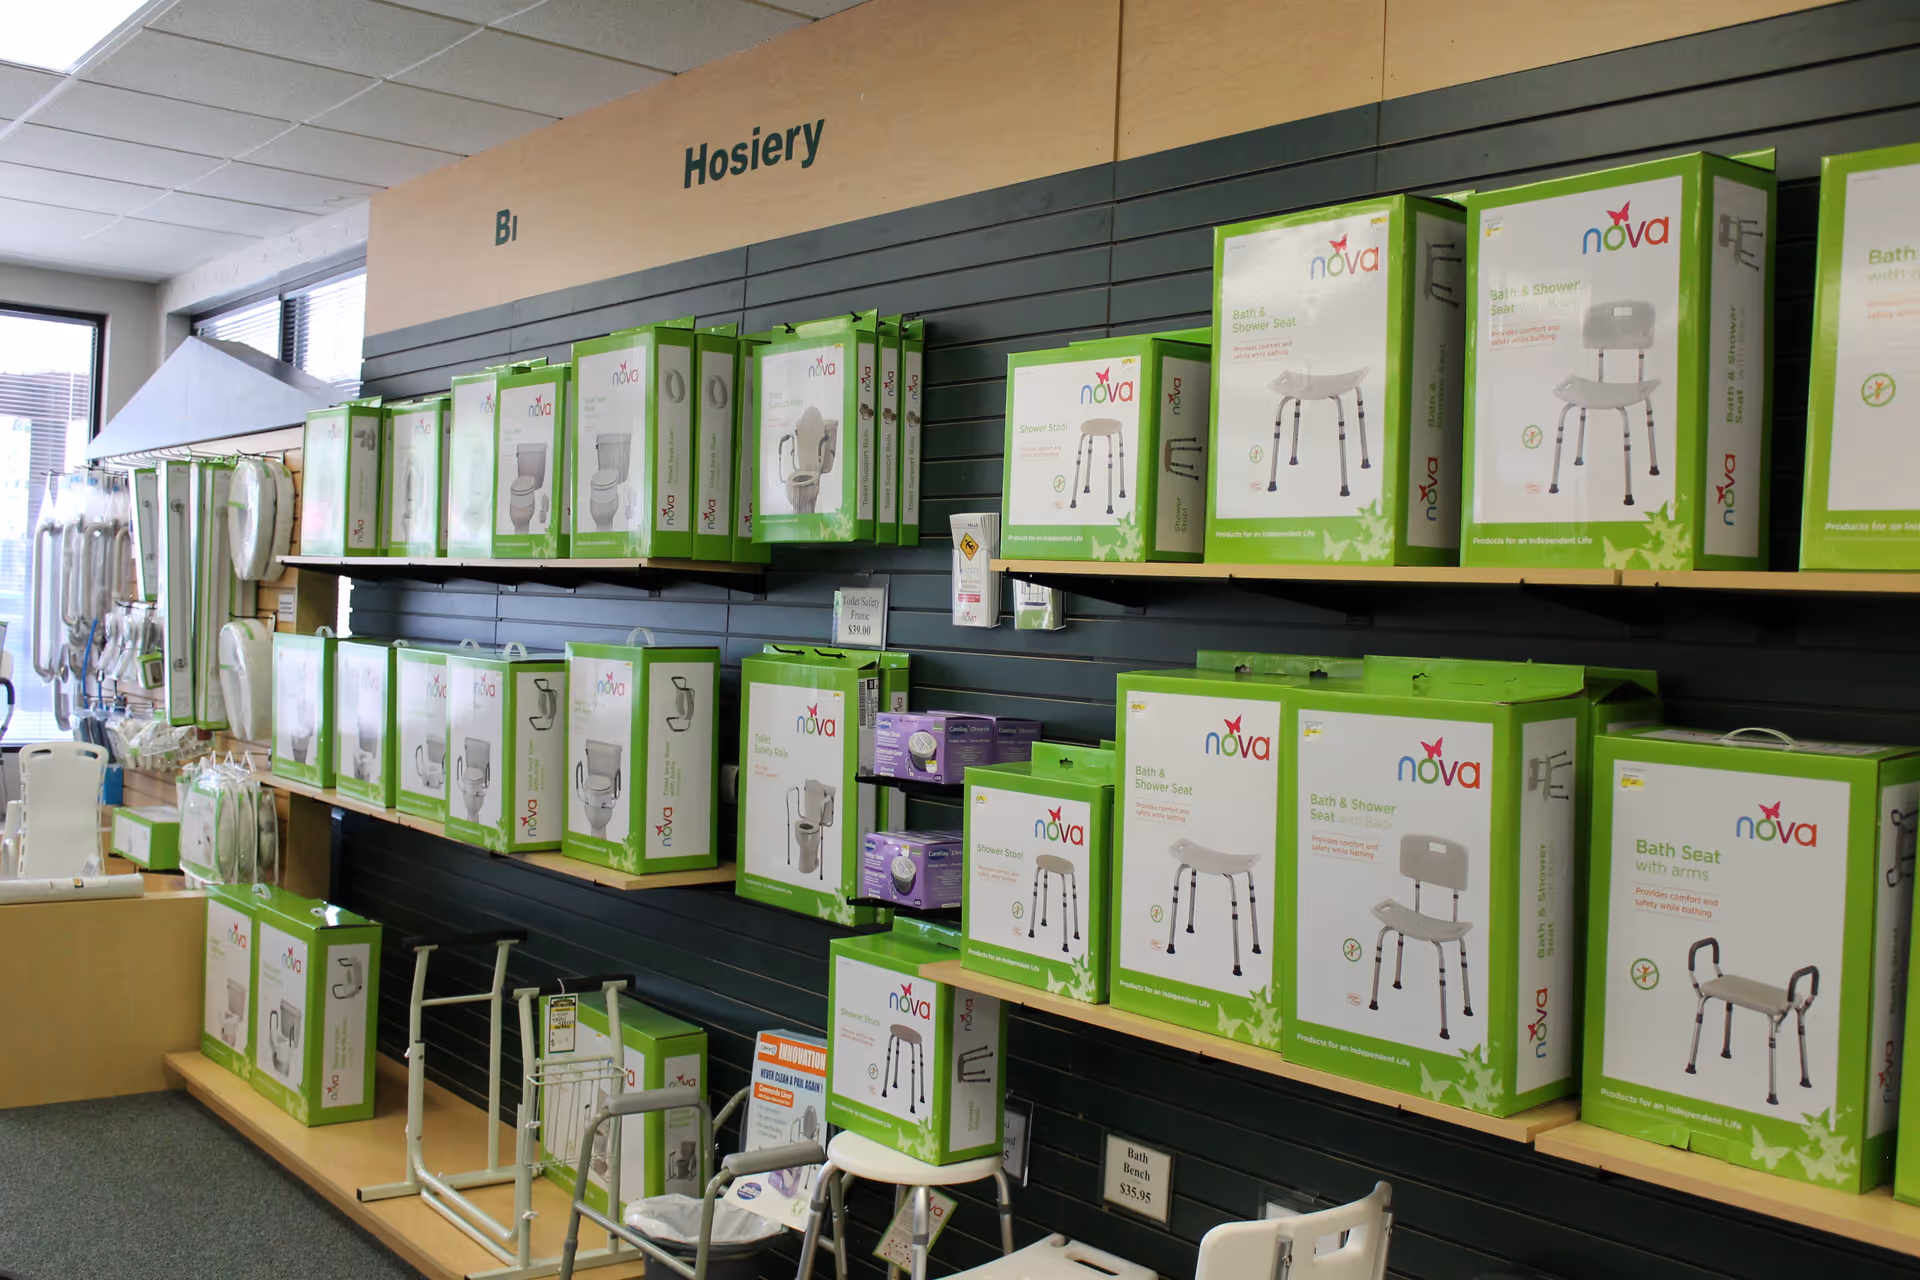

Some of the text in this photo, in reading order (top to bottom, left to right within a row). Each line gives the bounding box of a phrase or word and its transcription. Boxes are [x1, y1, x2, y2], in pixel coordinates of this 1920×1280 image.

[684, 119, 826, 189] Hosiery
[1583, 216, 1669, 255] nova
[1311, 245, 1379, 280] nova
[1869, 246, 1916, 265] Bath
[1521, 285, 1529, 296] &
[1533, 281, 1580, 296] Shower
[1232, 306, 1266, 320] Bath &
[1491, 304, 1515, 316] Seat
[1232, 317, 1297, 334] Shower Seat
[1727, 304, 1737, 365] Shower
[613, 368, 638, 386] nova
[809, 362, 836, 378] nova
[864, 366, 872, 393] nova
[887, 370, 895, 397] nova
[911, 374, 919, 400] nova
[1081, 381, 1134, 405] nova
[1172, 377, 1181, 415] nova
[1726, 386, 1735, 424] Bath
[1735, 389, 1744, 425] Seat
[529, 401, 551, 418] nova
[1020, 421, 1068, 434] Shower Stool
[1426, 456, 1439, 521] nova
[1723, 454, 1736, 527] nova
[667, 494, 675, 526] nova
[707, 498, 716, 530] nova
[357, 519, 365, 543] nova
[1303, 529, 1316, 537] Life
[1824, 522, 1869, 531] Products
[1872, 521, 1887, 531] for
[1472, 537, 1504, 545] Products
[1505, 537, 1516, 545] for
[1529, 536, 1576, 545] Independent
[1577, 535, 1593, 545] Life
[843, 595, 881, 609] Toilet Safety
[850, 610, 870, 621] Frame
[848, 624, 871, 636] $39.00
[473, 681, 496, 698] nova
[597, 679, 625, 696] nova
[797, 715, 836, 737] nova
[754, 733, 771, 744] Toilet
[1206, 731, 1270, 761] nova
[754, 744, 772, 757] Safety
[1135, 765, 1166, 779] Bath &
[1398, 755, 1481, 789] nova
[1135, 778, 1193, 796] Shower Seat
[1310, 793, 1398, 816] Bath & Shower
[1310, 808, 1335, 822] Seat
[528, 799, 538, 837] nova
[662, 806, 673, 848] nova
[1034, 818, 1084, 847] nova
[1736, 815, 1818, 848] nova
[976, 843, 1024, 860] Shower Stool
[1311, 835, 1379, 851] Provides comfort and
[1311, 843, 1331, 853] safety
[1349, 848, 1375, 860] bathing
[1635, 839, 1721, 865] Bath Seat
[1537, 843, 1547, 903] Shower
[1635, 860, 1710, 881] with arms
[1634, 886, 1719, 907] Provides comfort and
[1634, 898, 1713, 919] safety while bathing
[227, 927, 247, 949] nova
[1537, 922, 1546, 959] Bath
[281, 952, 302, 973] nova
[967, 948, 988, 958] Products
[1119, 979, 1144, 992] Products
[1144, 985, 1153, 993] for
[1161, 990, 1198, 1005] Independent
[1199, 999, 1210, 1008] Life
[889, 991, 931, 1020] nova
[963, 998, 973, 1032] nova
[1535, 988, 1548, 1059] nova
[779, 1042, 827, 1071] INNOVATION
[1296, 1032, 1411, 1067] Products for an Independent Life
[760, 1067, 820, 1094] NEVER CLEAN A PAIL AGAIN
[1882, 1041, 1894, 1104] nova
[759, 1084, 793, 1100] Commode Liner
[1600, 1087, 1742, 1130] Products for an Independent Life
[1127, 1147, 1149, 1165] Bath
[1123, 1162, 1151, 1182] Bench
[1119, 1183, 1152, 1204] $35.95
